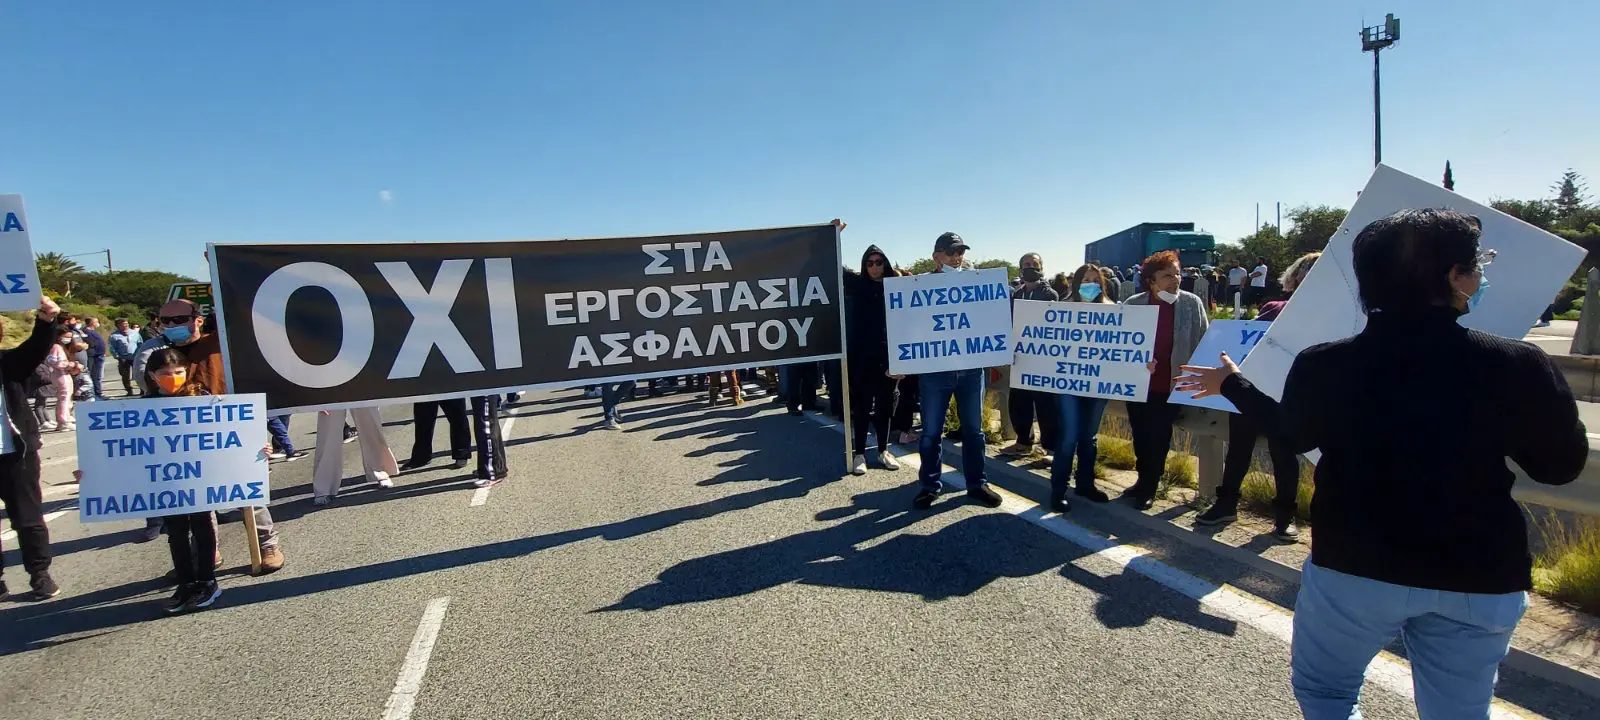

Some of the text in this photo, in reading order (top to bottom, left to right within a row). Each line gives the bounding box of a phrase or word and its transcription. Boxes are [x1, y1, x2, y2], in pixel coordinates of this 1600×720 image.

[642, 241, 732, 275] ΣΤΑ
[545, 276, 829, 326] ΕΡΓΟΣΤΑΣΙΑ
[889, 283, 1007, 309] Η ΔΥΣΟΣΜΙΑ
[252, 257, 523, 388] ΟΧΙ
[932, 313, 971, 331] ΣΤΑ
[1045, 310, 1123, 326] ΟΤΙ ΕΙΝΑΙ
[567, 317, 814, 369] ΑΣΦΑΛΤΟΥ
[898, 334, 1007, 360] ΣΠΙΤΙΑ ΜΑΣ
[1021, 326, 1145, 345] ΑΝΕΠΙΘΥΜΗΤΟ
[1014, 342, 1150, 363] ΑΛΛΟΥ ΕΡΧΕΤΑΙ
[1056, 362, 1100, 377] ΣΤΗΝ
[1021, 374, 1136, 396] ΠΕΡΙΟΧΗ ΜΑΣ
[88, 403, 254, 431] ΣΕΒΑΣΤΕΙΤΕ
[102, 431, 242, 457] ΤΗΝ ΥΓΕΙΑ
[145, 461, 201, 482] ΤΩΝ
[86, 481, 264, 516] ΠΑΙΔΙΩΝ ΜΑΣ
